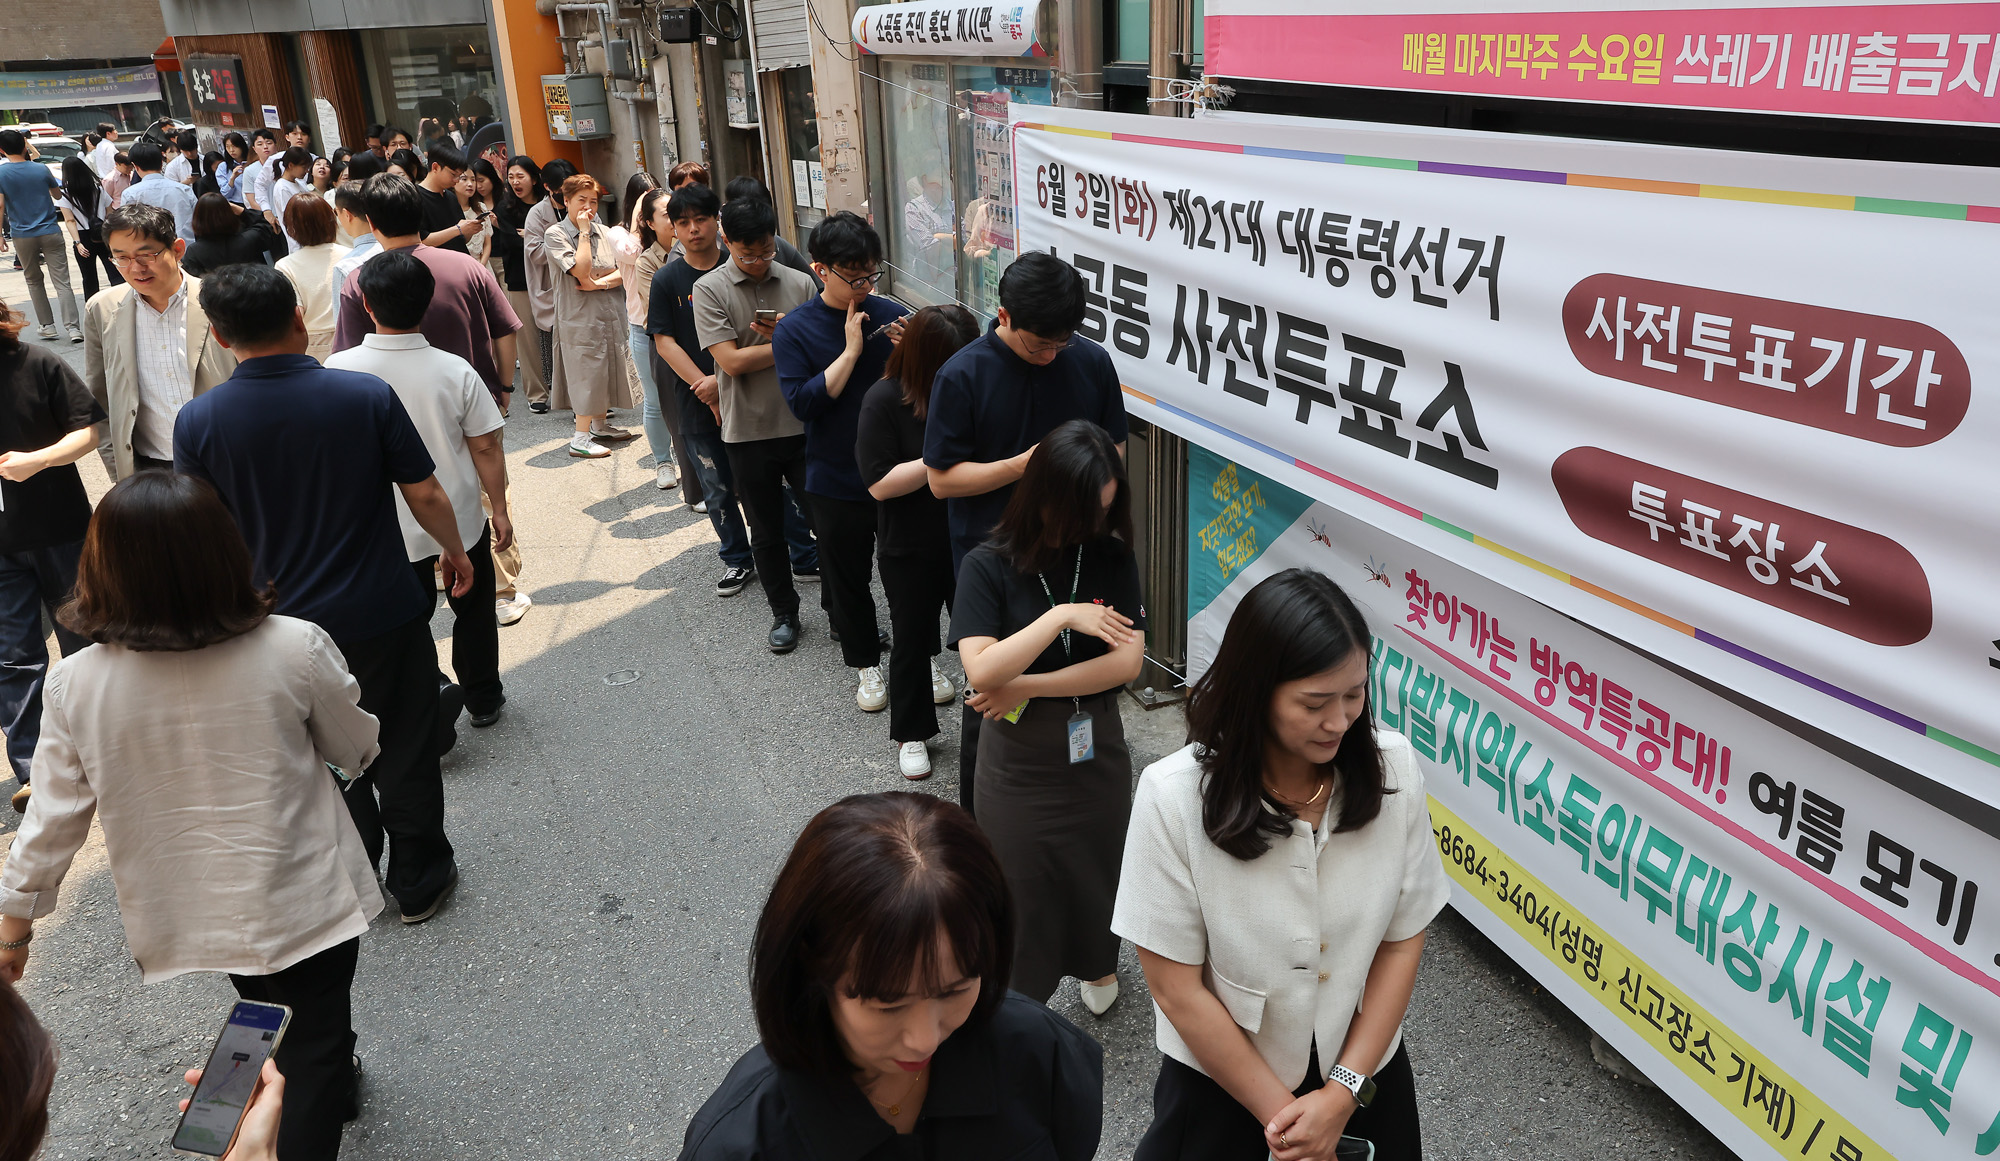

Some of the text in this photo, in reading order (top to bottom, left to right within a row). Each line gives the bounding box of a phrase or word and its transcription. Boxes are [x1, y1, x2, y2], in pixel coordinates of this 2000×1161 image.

[875, 6, 994, 44] 소공동 주민 홍보 게시판
[1402, 33, 1446, 76] 매월
[1454, 32, 1559, 81] 마지막주
[1567, 32, 1664, 86] 수요일
[1673, 32, 1791, 90] 쓰레기
[1036, 162, 1506, 321] 6월 3일(화) 제21대 대통령선거
[1050, 246, 1499, 491] 공동 사전투표소
[1584, 295, 1943, 431] 사전투표기간
[1197, 498, 1243, 552] 지긋지긋한
[1212, 461, 1240, 502] 여름철
[1628, 480, 1851, 606] 투표장소
[1216, 525, 1259, 580] 힘드셨죠?
[1404, 568, 1979, 946] 찾아가는 방역특공대! 여름 모기
[1428, 811, 1606, 991] -8684-3404(성명,
[1617, 964, 1717, 1076] 신고장소
[1726, 1050, 1796, 1141] 기재)
[1895, 1002, 1974, 1137] 및
